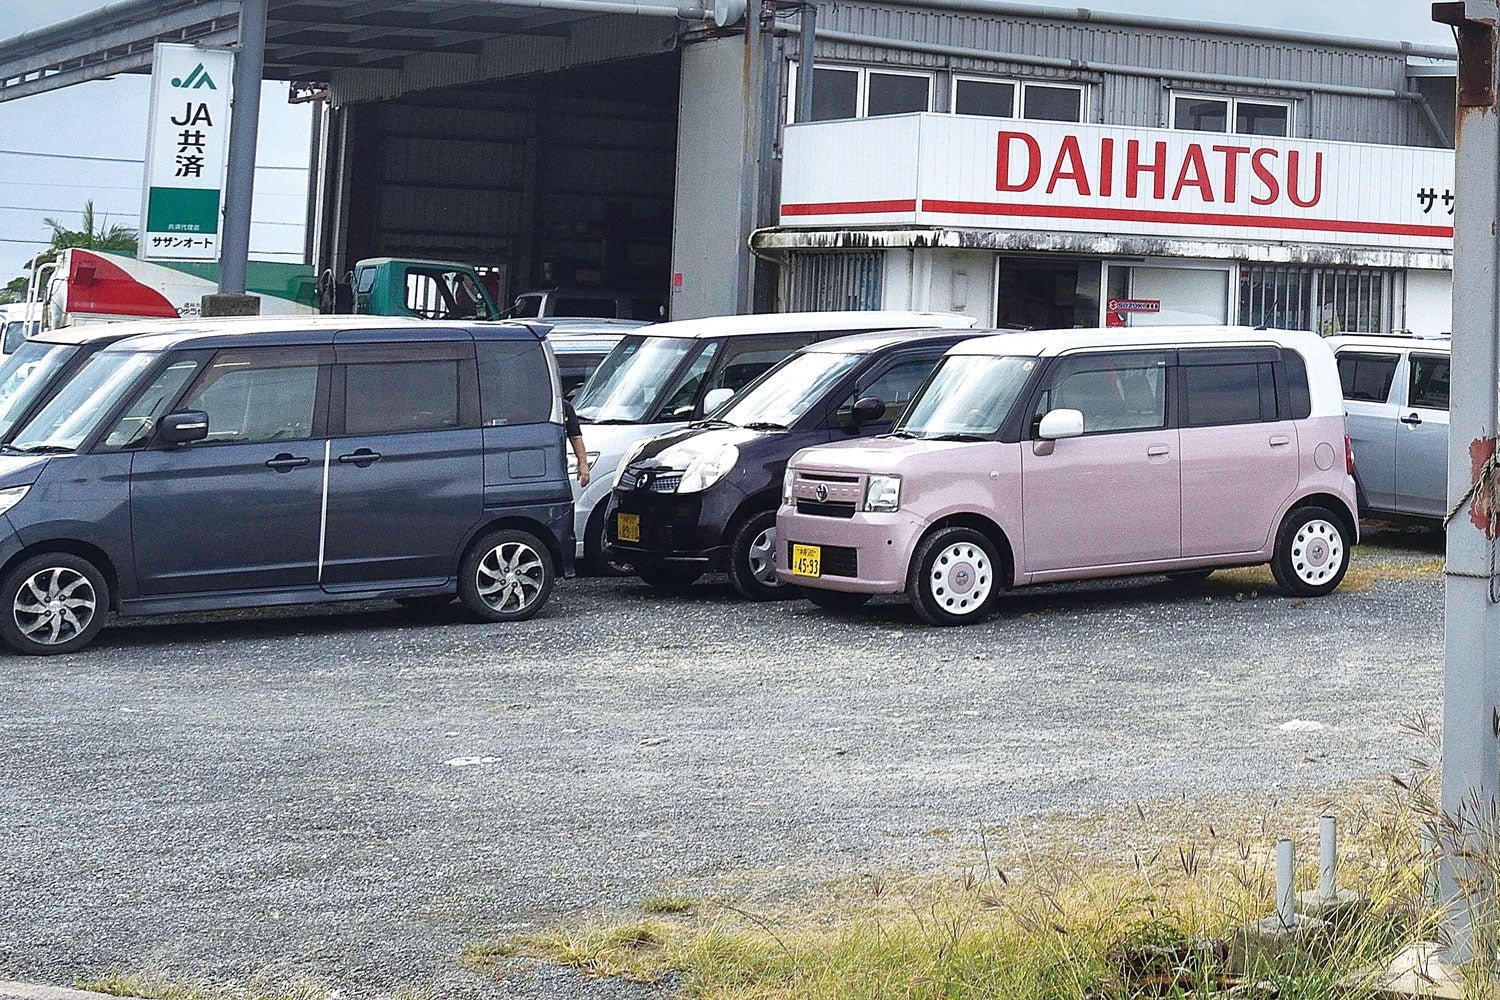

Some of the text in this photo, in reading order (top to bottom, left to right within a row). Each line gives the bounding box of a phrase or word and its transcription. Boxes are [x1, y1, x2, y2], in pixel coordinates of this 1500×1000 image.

[995, 131, 1322, 207] DAIHATSU
[152, 236, 214, 249] サザンオート
